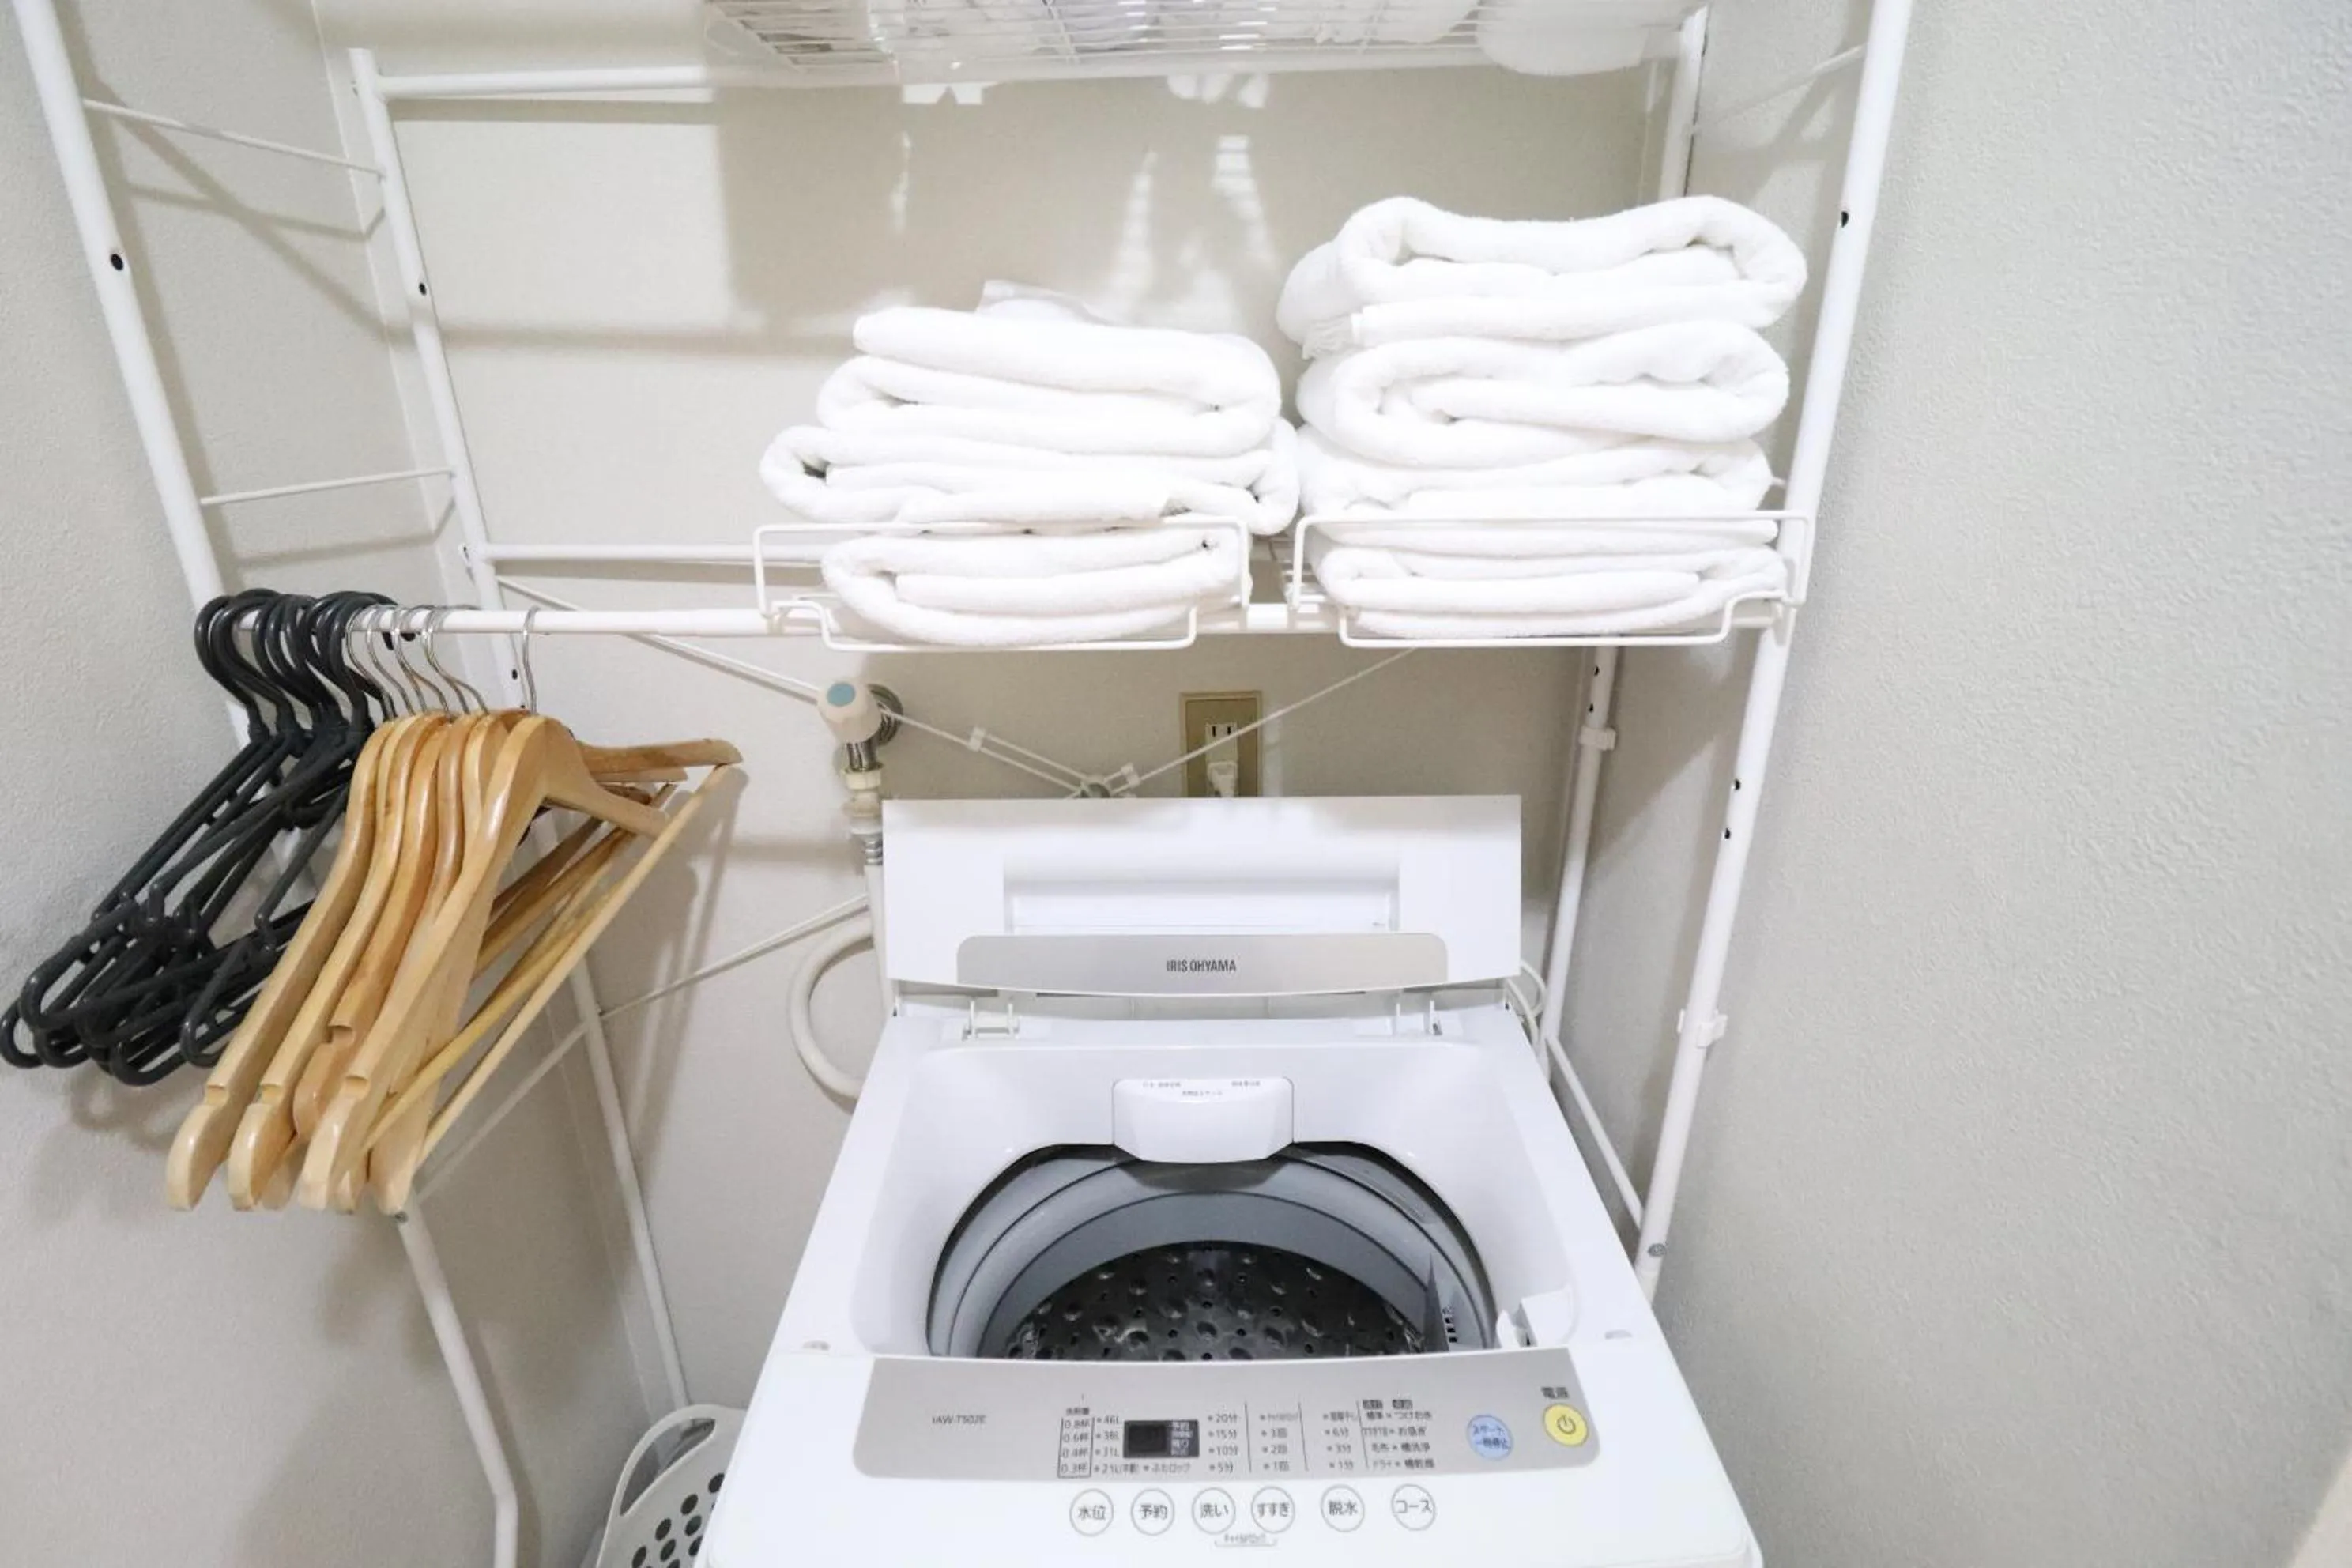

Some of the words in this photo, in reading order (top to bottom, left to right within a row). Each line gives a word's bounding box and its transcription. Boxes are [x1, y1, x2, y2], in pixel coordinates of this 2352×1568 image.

[1166, 959, 1188, 971] IRIS
[1189, 959, 1236, 971] OHYAMA
[1216, 1429, 1237, 1439] 15分
[1217, 1446, 1238, 1456] 10分
[1077, 1505, 1106, 1521] 水位
[1140, 1503, 1168, 1519] 予約
[1200, 1503, 1229, 1518] 洗い
[1257, 1502, 1290, 1517] すすぎ
[1328, 1499, 1358, 1516] 脱水
[1396, 1500, 1433, 1513] コース
